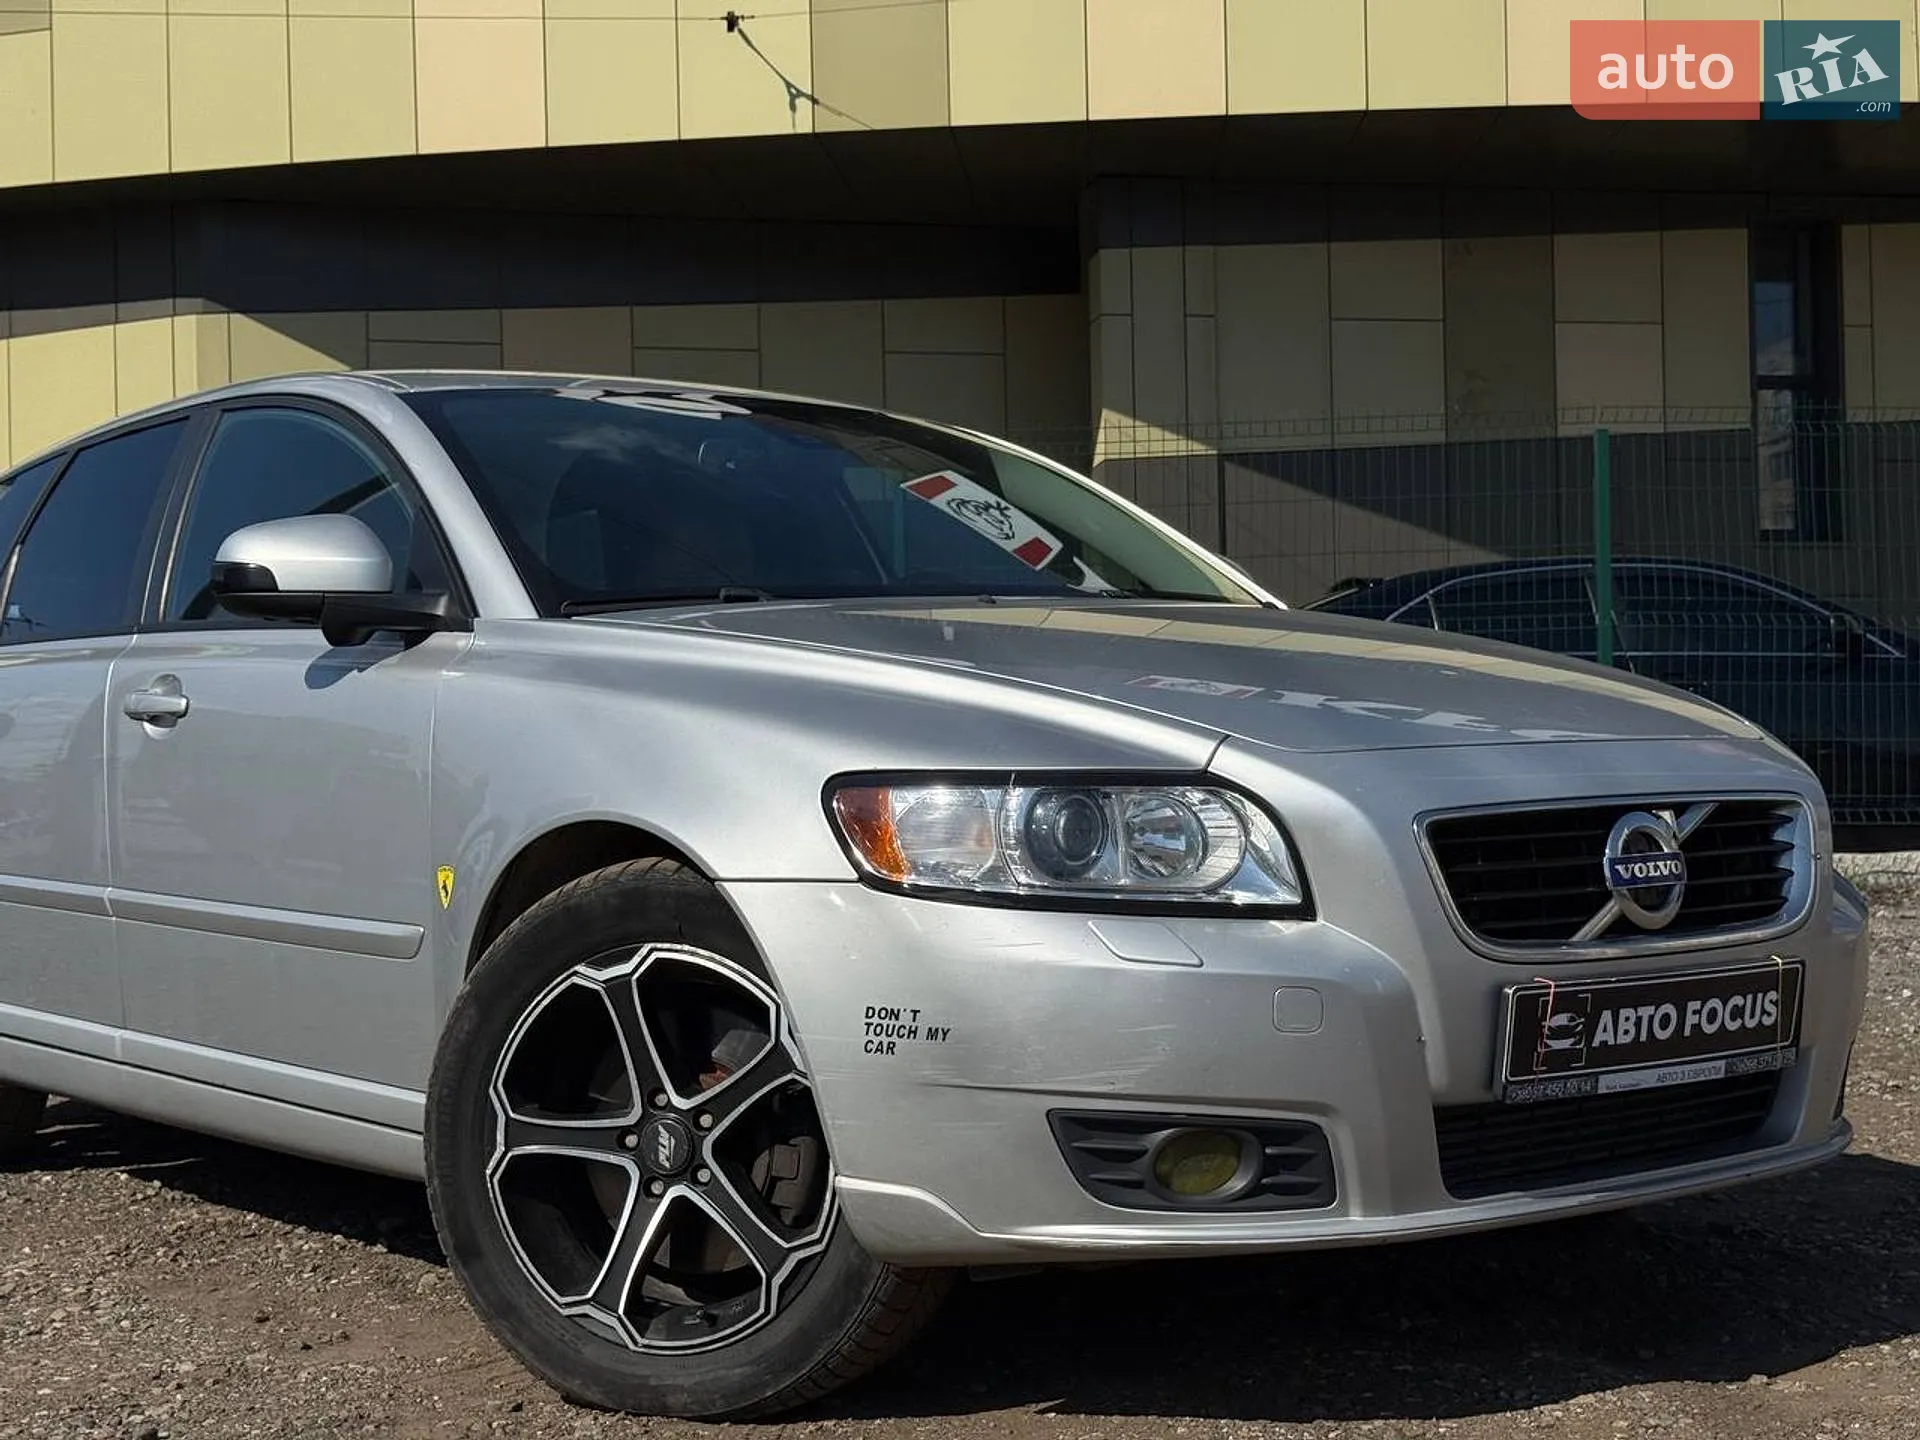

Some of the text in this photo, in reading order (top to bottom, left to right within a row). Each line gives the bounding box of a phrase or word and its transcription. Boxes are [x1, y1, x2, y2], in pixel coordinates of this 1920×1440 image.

[1615, 861, 1681, 879] VOLVO
[1683, 990, 1778, 1035] FOCUS
[864, 1022, 951, 1042] TOUCH MY
[864, 1040, 897, 1056] CAR
